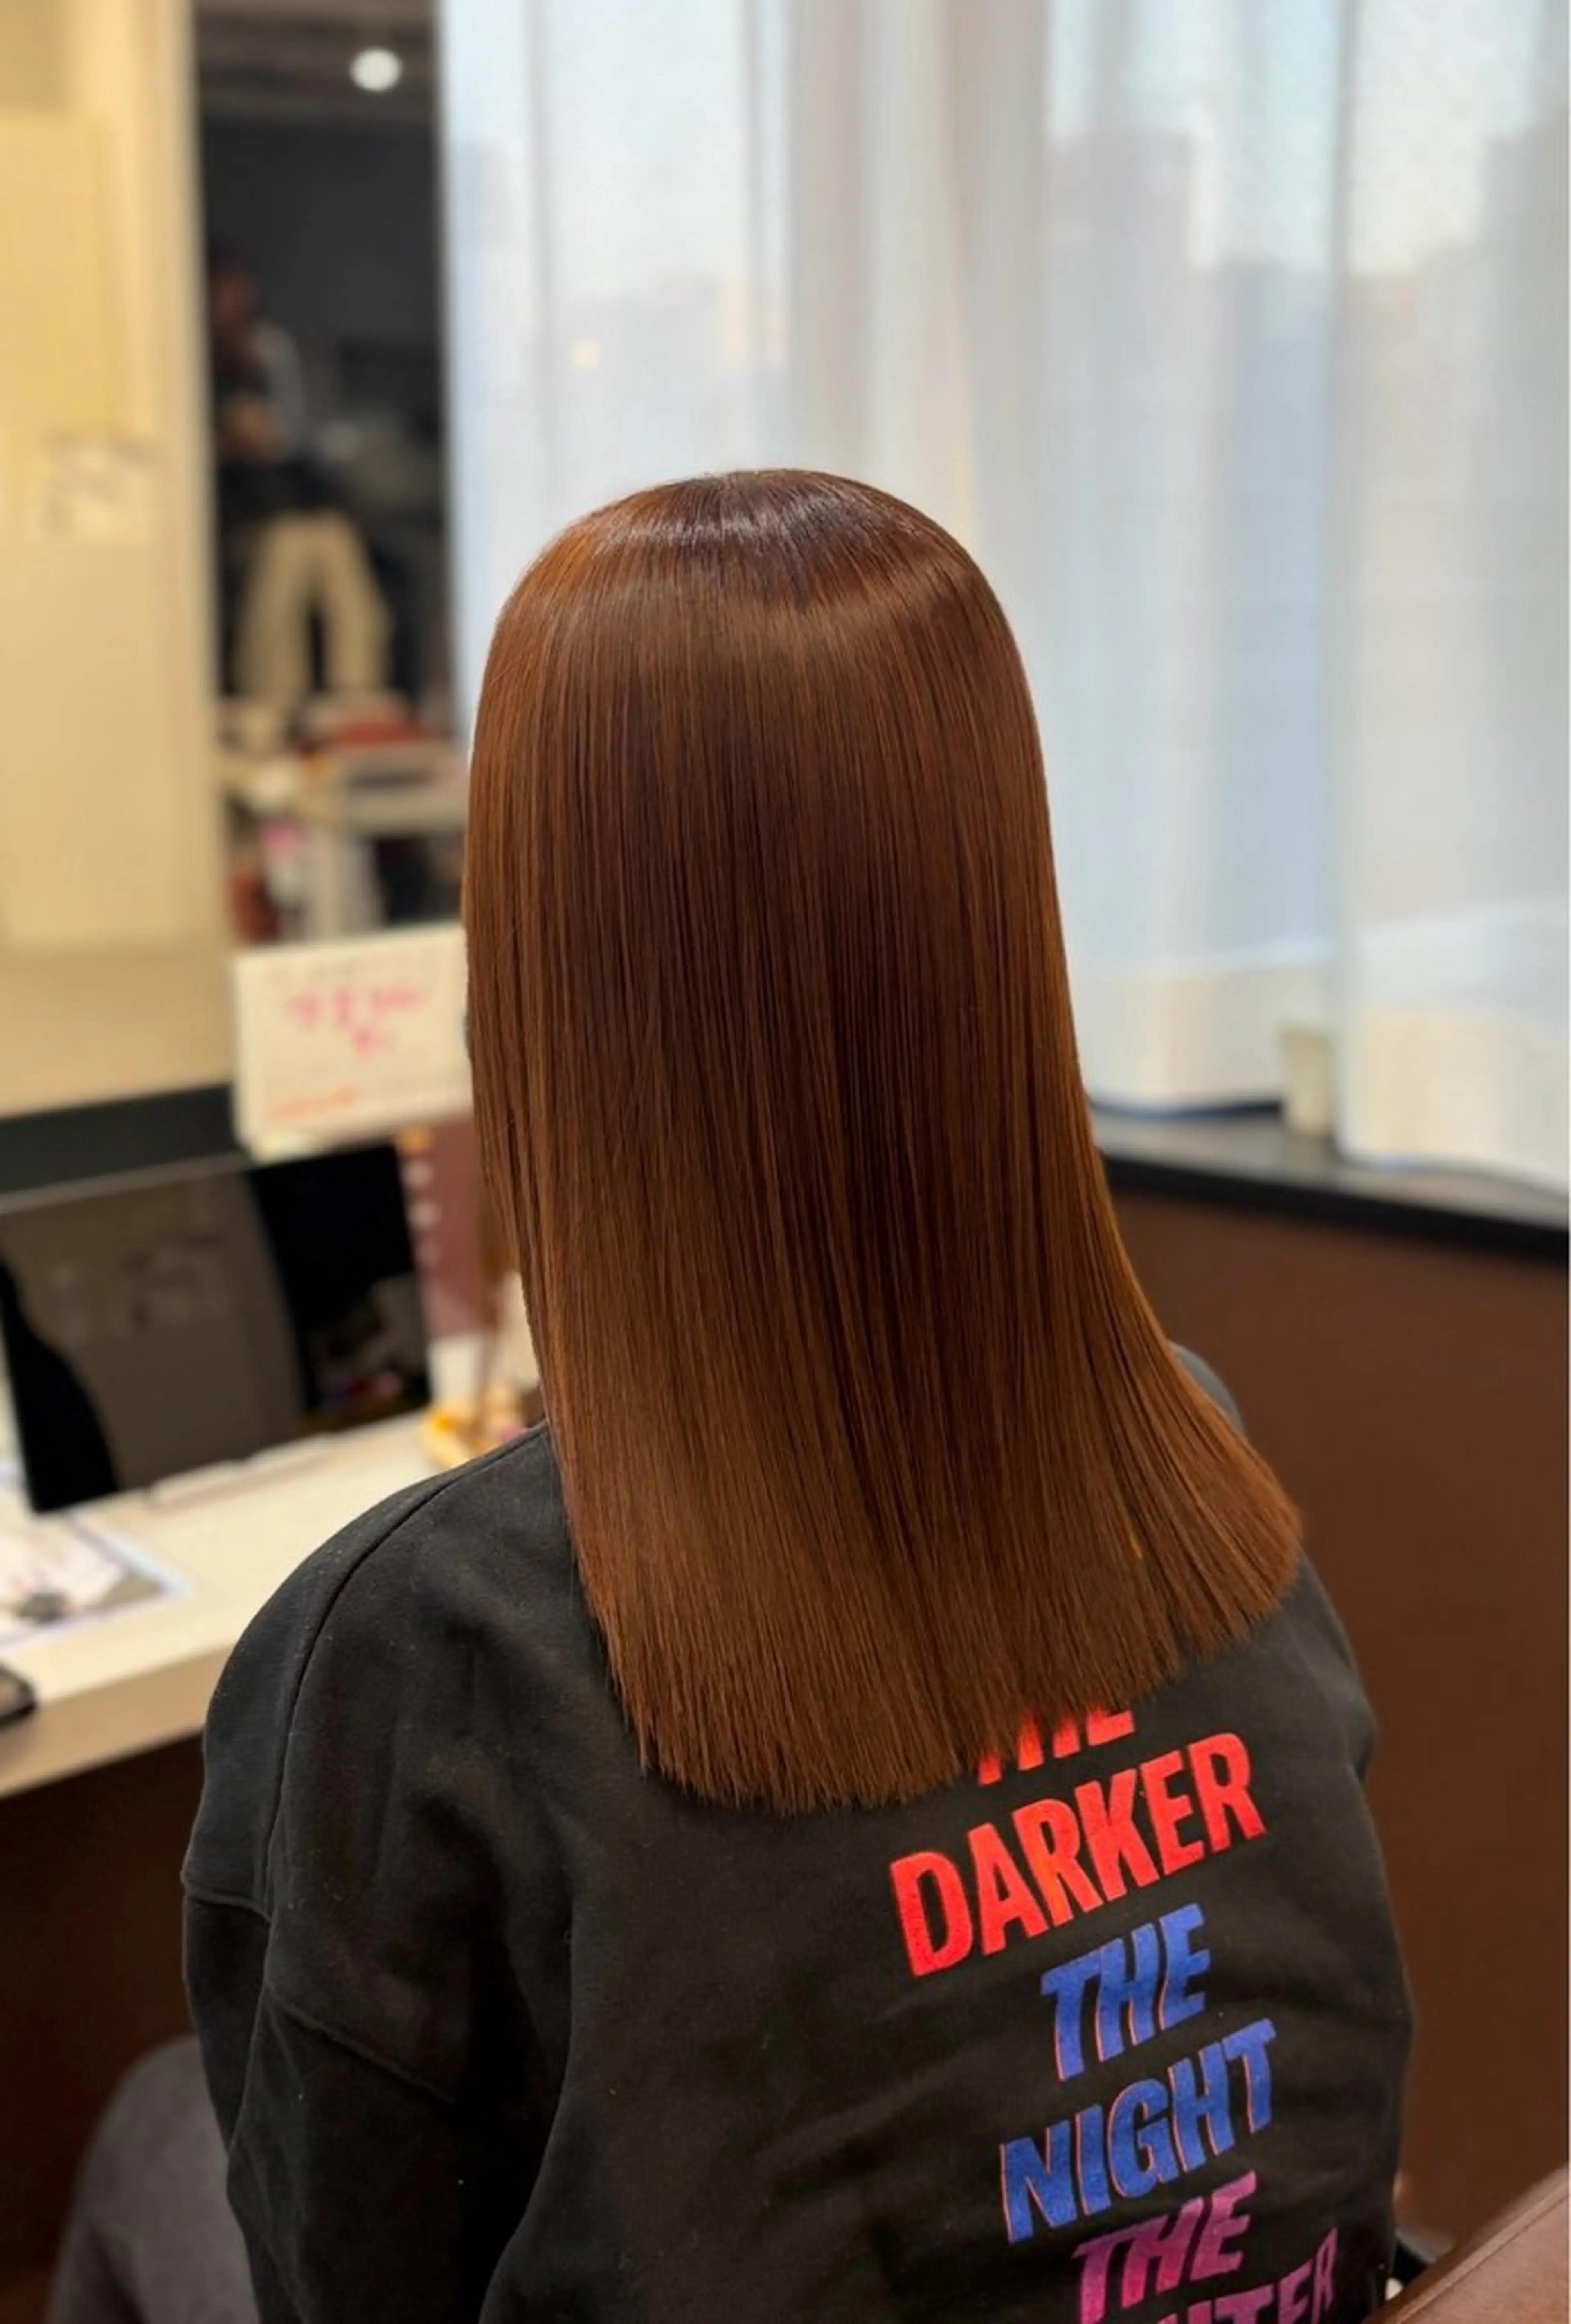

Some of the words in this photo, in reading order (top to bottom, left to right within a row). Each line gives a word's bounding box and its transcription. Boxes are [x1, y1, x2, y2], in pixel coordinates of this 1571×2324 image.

[889, 1733, 1267, 1977] DARKER
[1040, 1903, 1211, 2081] THE
[999, 2018, 1276, 2244] NIGHT
[1071, 2170, 1257, 2324] THE
